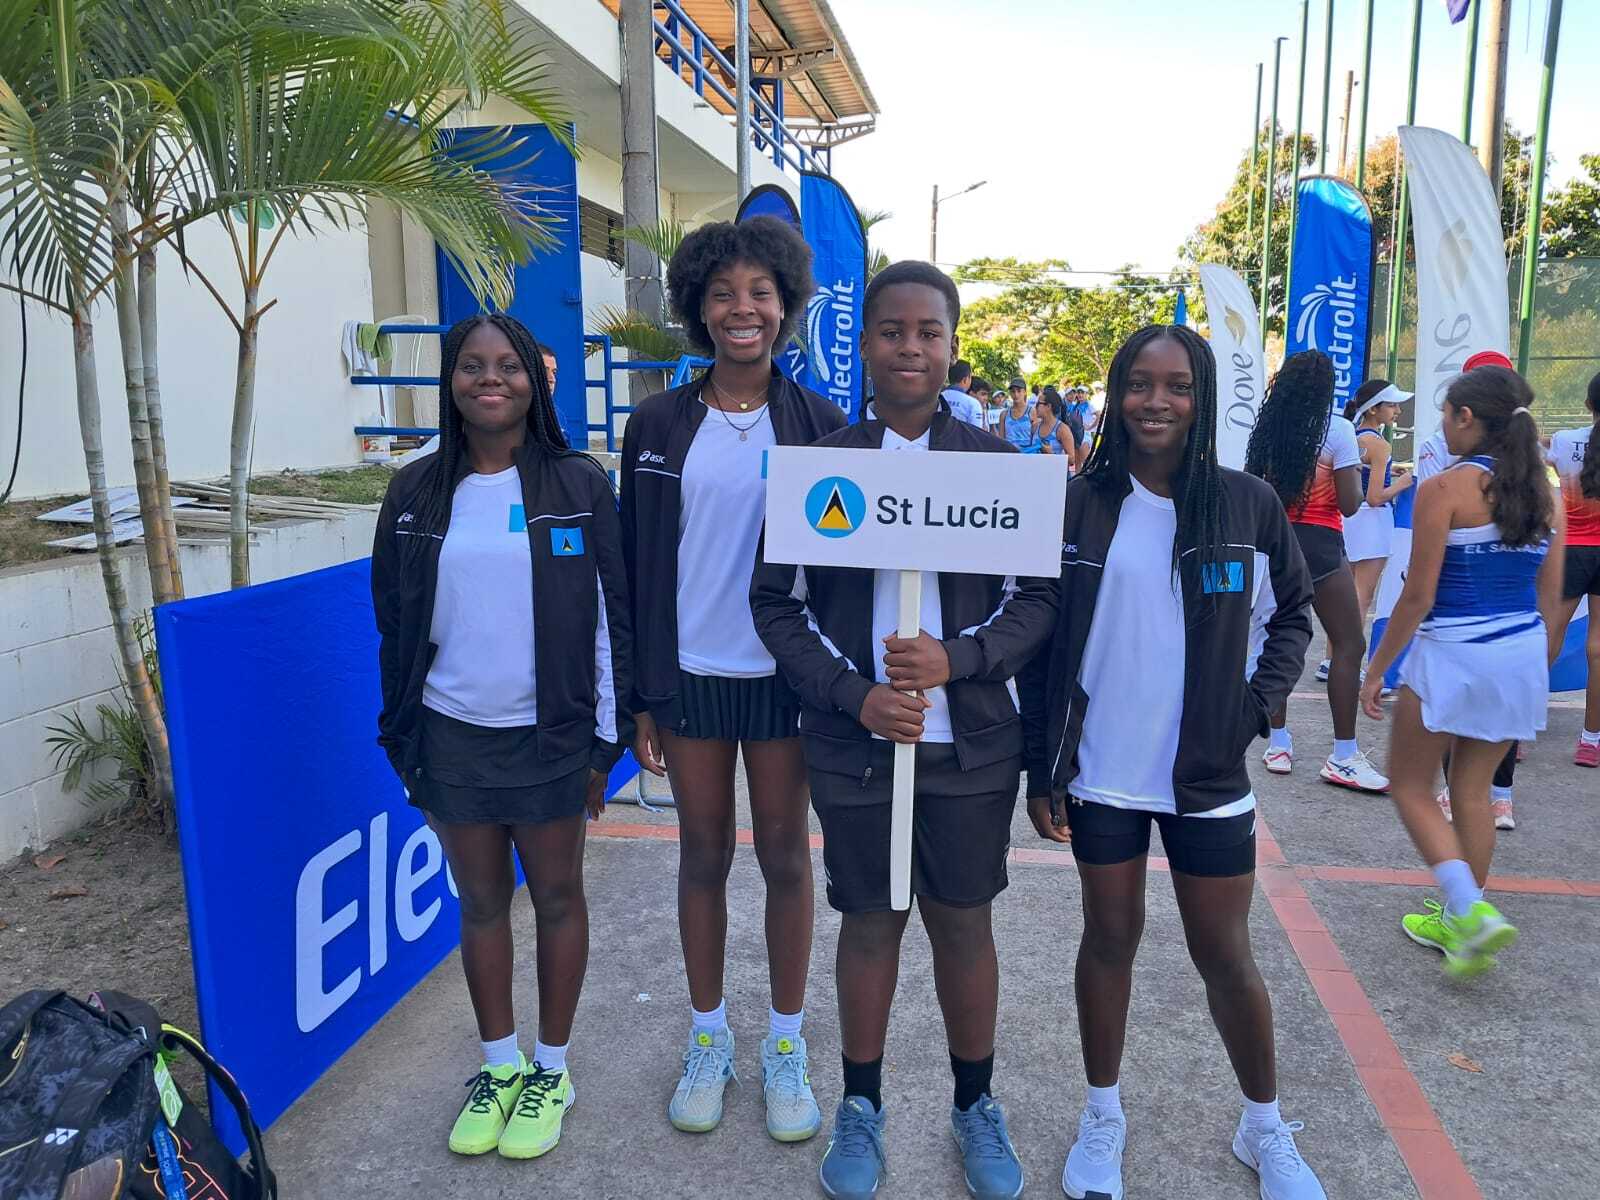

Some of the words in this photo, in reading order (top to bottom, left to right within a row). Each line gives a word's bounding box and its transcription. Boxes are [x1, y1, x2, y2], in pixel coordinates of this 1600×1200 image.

[1225, 352, 1256, 432] Dove
[876, 494, 913, 526] St
[924, 495, 1020, 530] Lucía
